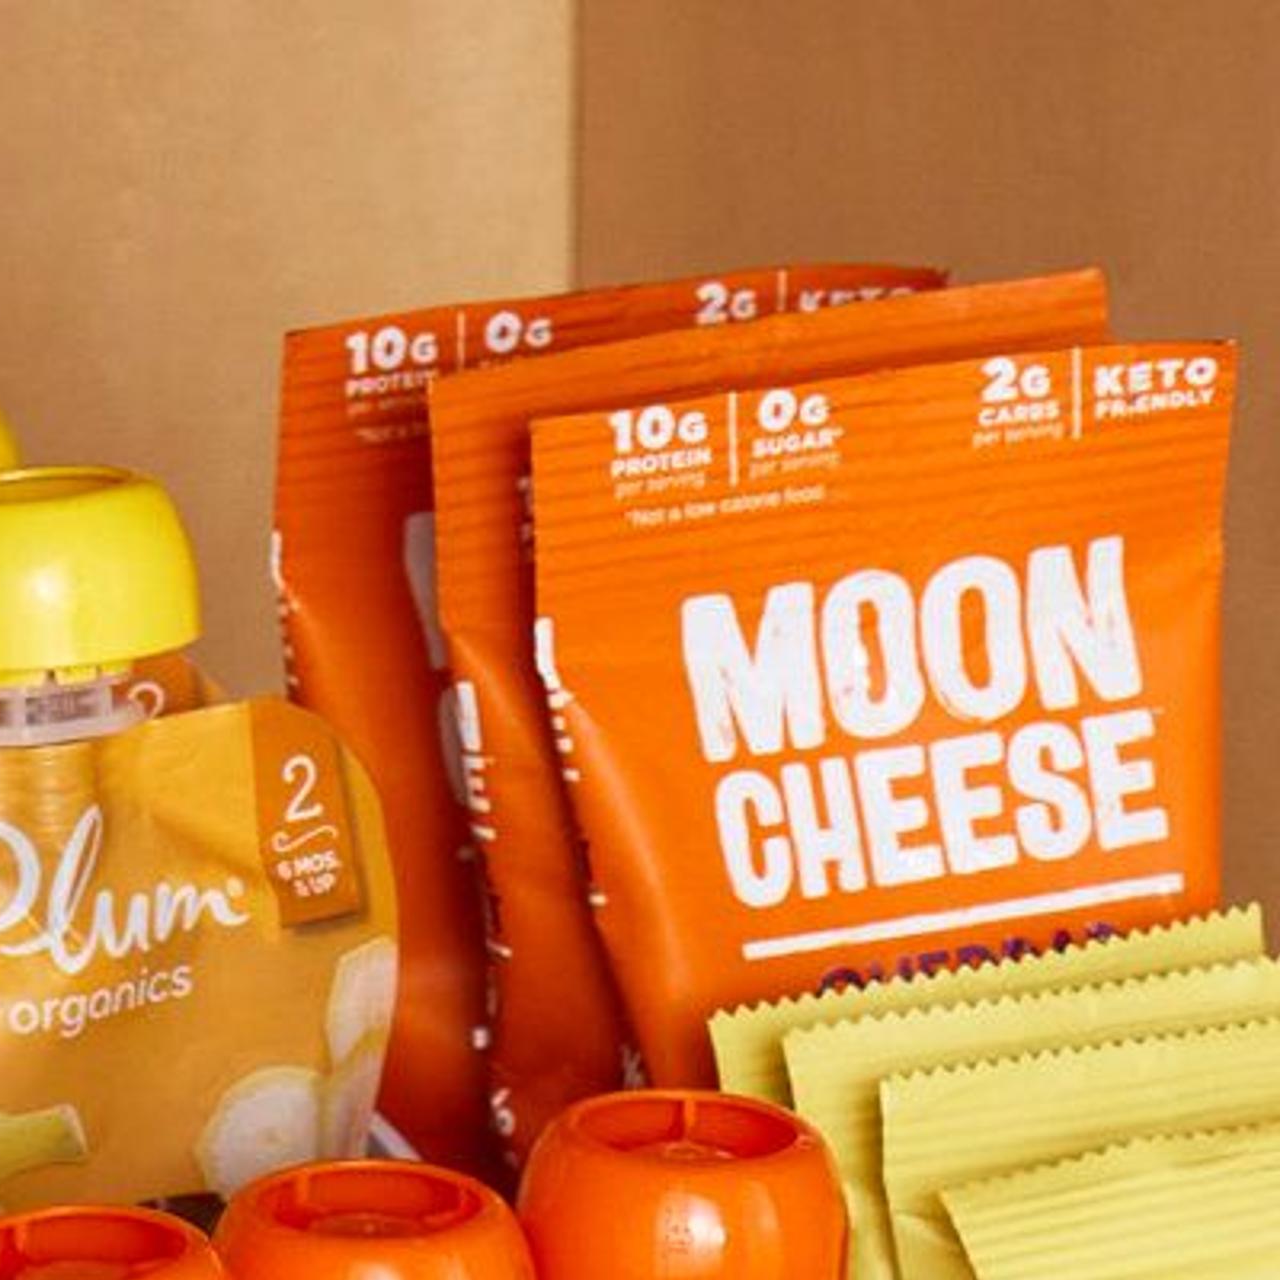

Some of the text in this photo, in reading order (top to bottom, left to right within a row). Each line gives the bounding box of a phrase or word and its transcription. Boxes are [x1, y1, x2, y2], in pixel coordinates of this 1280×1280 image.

[979, 356, 1051, 402] 2G
[1093, 356, 1218, 398] KETO
[608, 404, 709, 454] 10G
[757, 388, 831, 432] 0G
[978, 401, 1061, 428] CARBS
[610, 447, 713, 478] PROTEIN
[680, 535, 1146, 764] MOON
[280, 754, 324, 823] 2
[713, 708, 1171, 909] CHEESE
[8, 964, 194, 1039] organics
